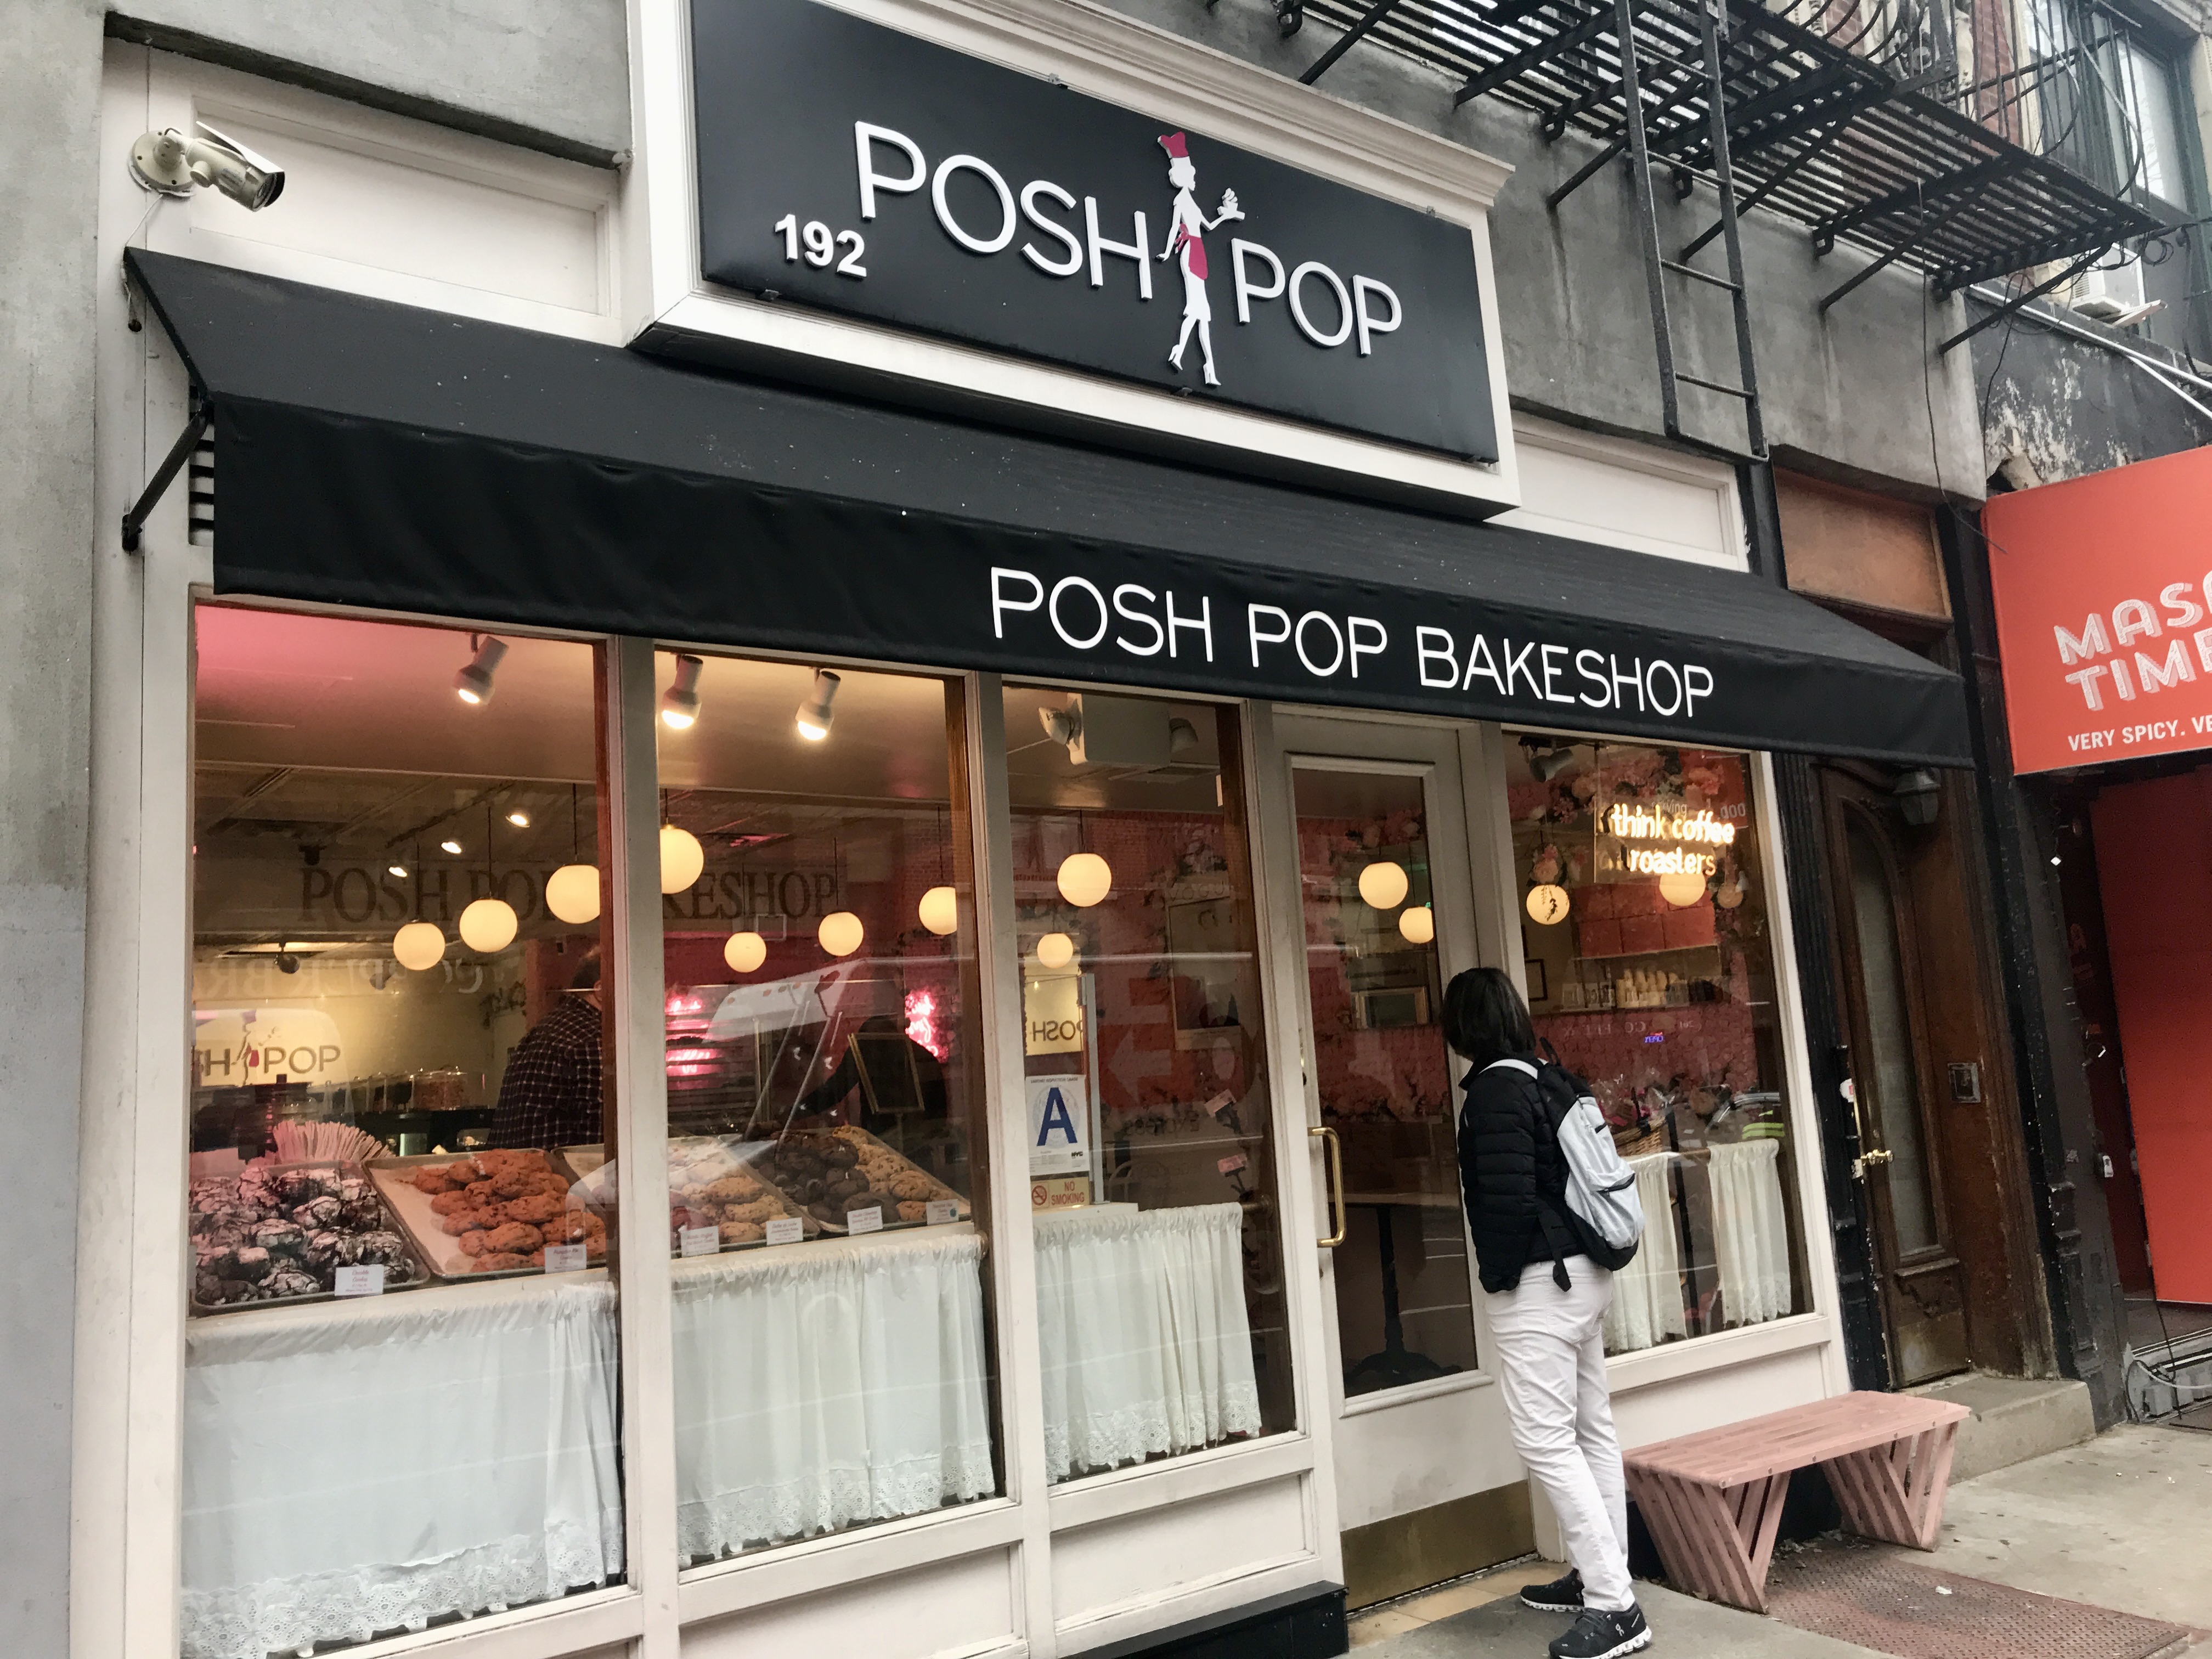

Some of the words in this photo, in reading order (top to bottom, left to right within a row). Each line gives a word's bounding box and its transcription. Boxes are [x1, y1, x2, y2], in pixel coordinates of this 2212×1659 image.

[774, 213, 867, 278] 192
[854, 121, 1153, 300] POSH
[1231, 238, 1402, 356] POP
[991, 567, 1214, 662] POSH
[1248, 603, 1387, 679] POP
[1416, 625, 1714, 718] BAKESHOP
[2068, 729, 2115, 752] VERY
[2122, 719, 2186, 744] SPICY.
[1610, 803, 1667, 839] think
[1672, 809, 1735, 844] coffee
[1629, 847, 1716, 877] roasters
[264, 1045, 341, 1074] POP
[1036, 1087, 1077, 1147] A
[1051, 1192, 1085, 1205] SMOKING
[1064, 1181, 1075, 1192] NO
